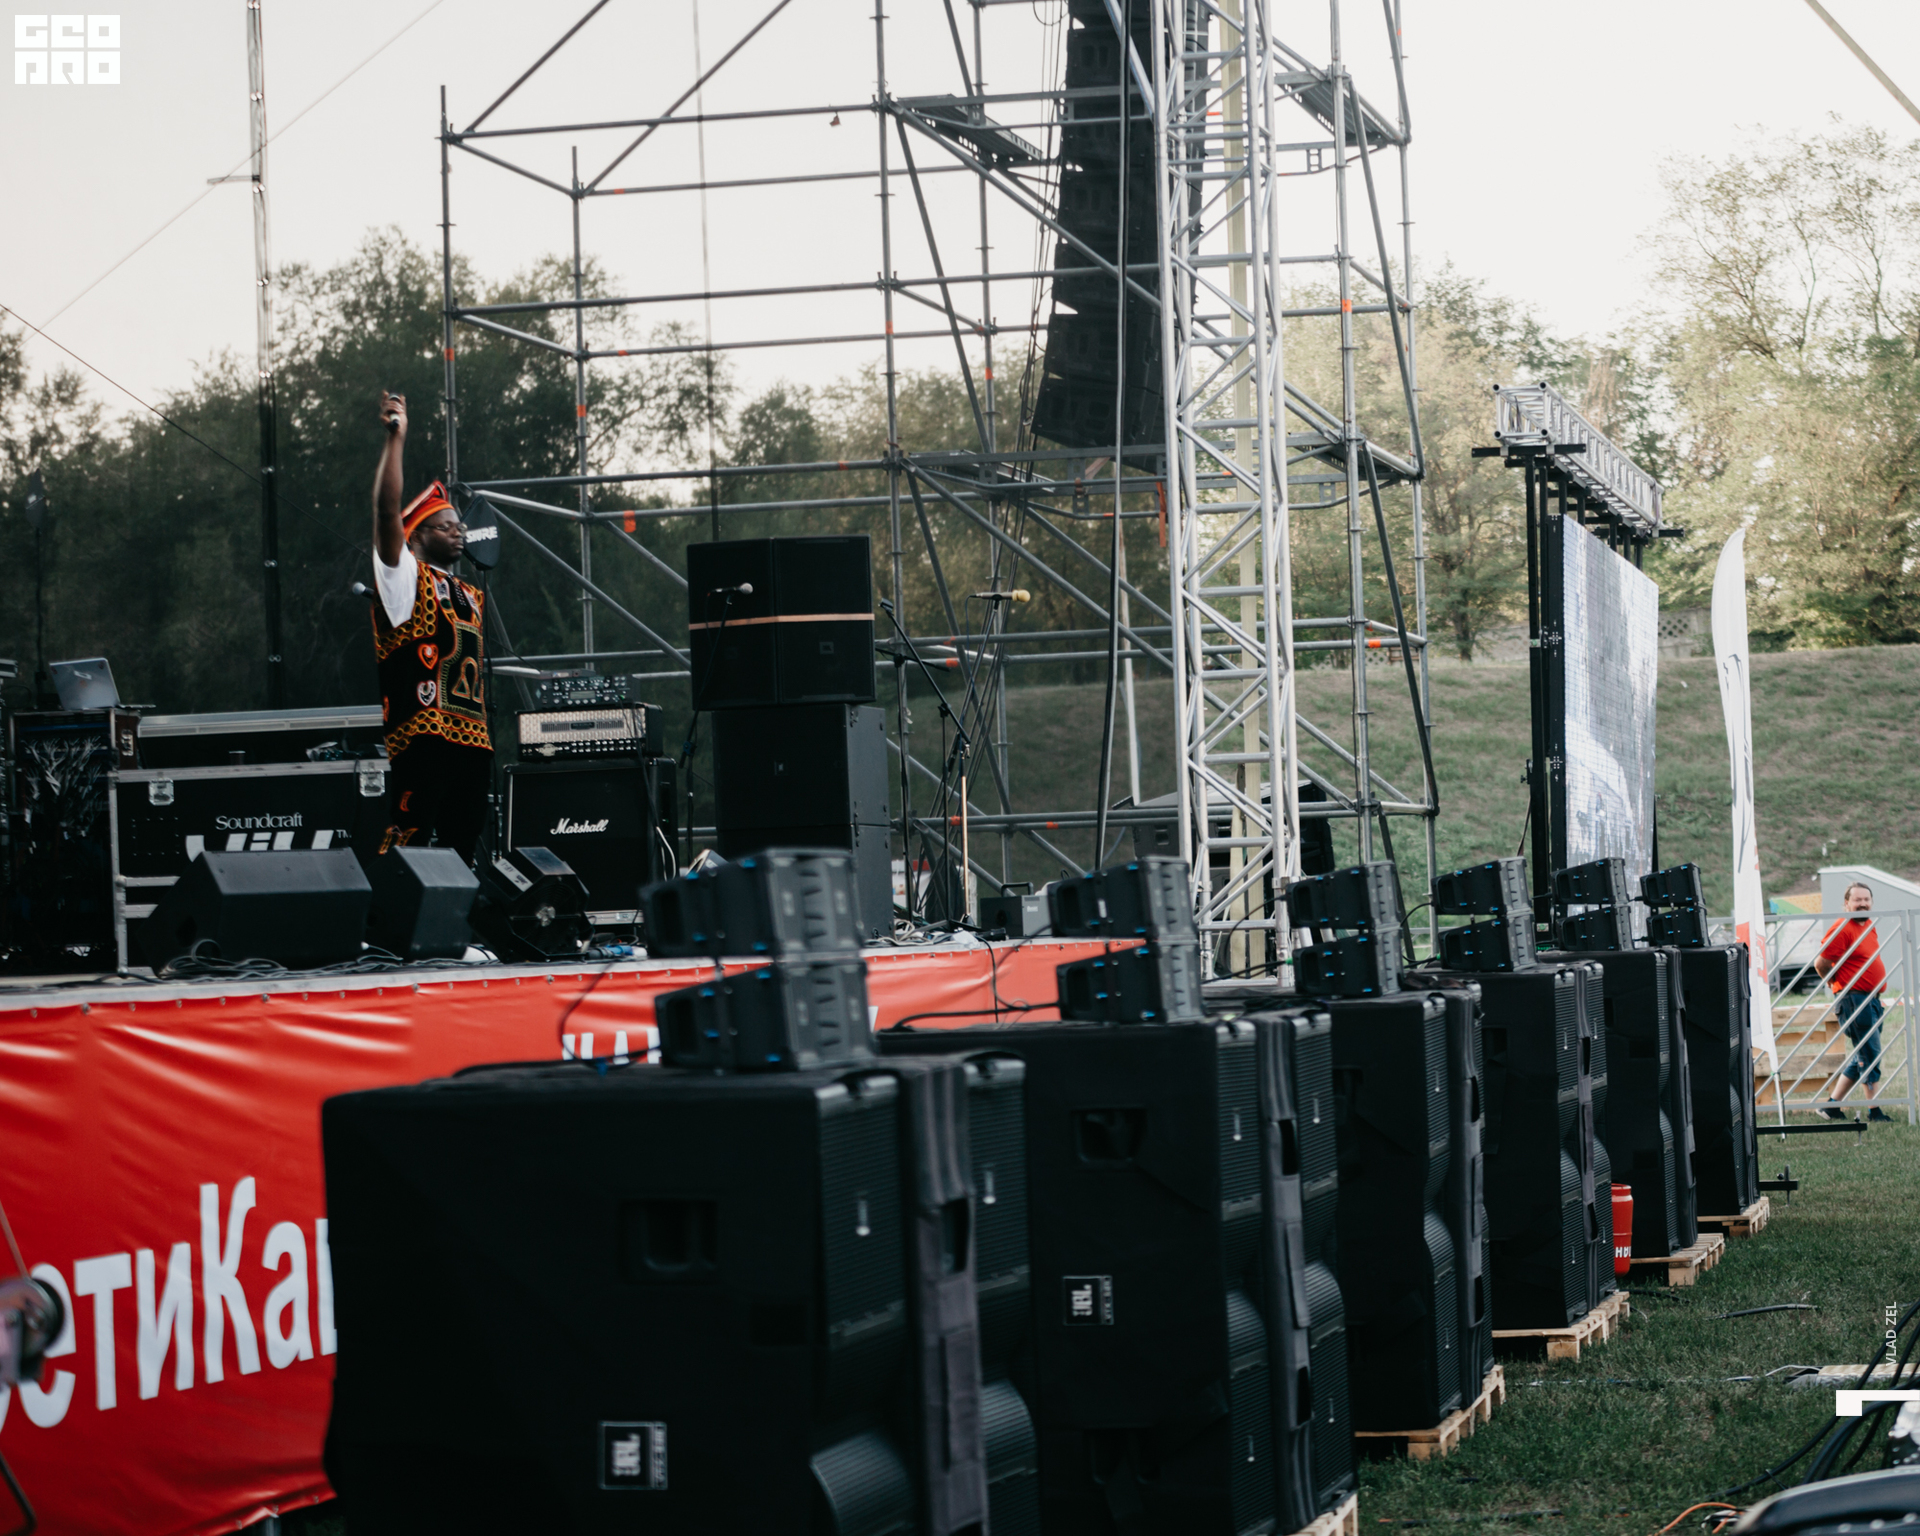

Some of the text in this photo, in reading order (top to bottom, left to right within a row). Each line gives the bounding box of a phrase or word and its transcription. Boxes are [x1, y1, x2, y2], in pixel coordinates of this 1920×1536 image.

[215, 812, 303, 831] Soundcraft
[550, 817, 609, 835] Marshall
[0, 1176, 337, 1434] етиКа
[1072, 1284, 1092, 1316] JBL
[612, 1433, 641, 1476] JBL
